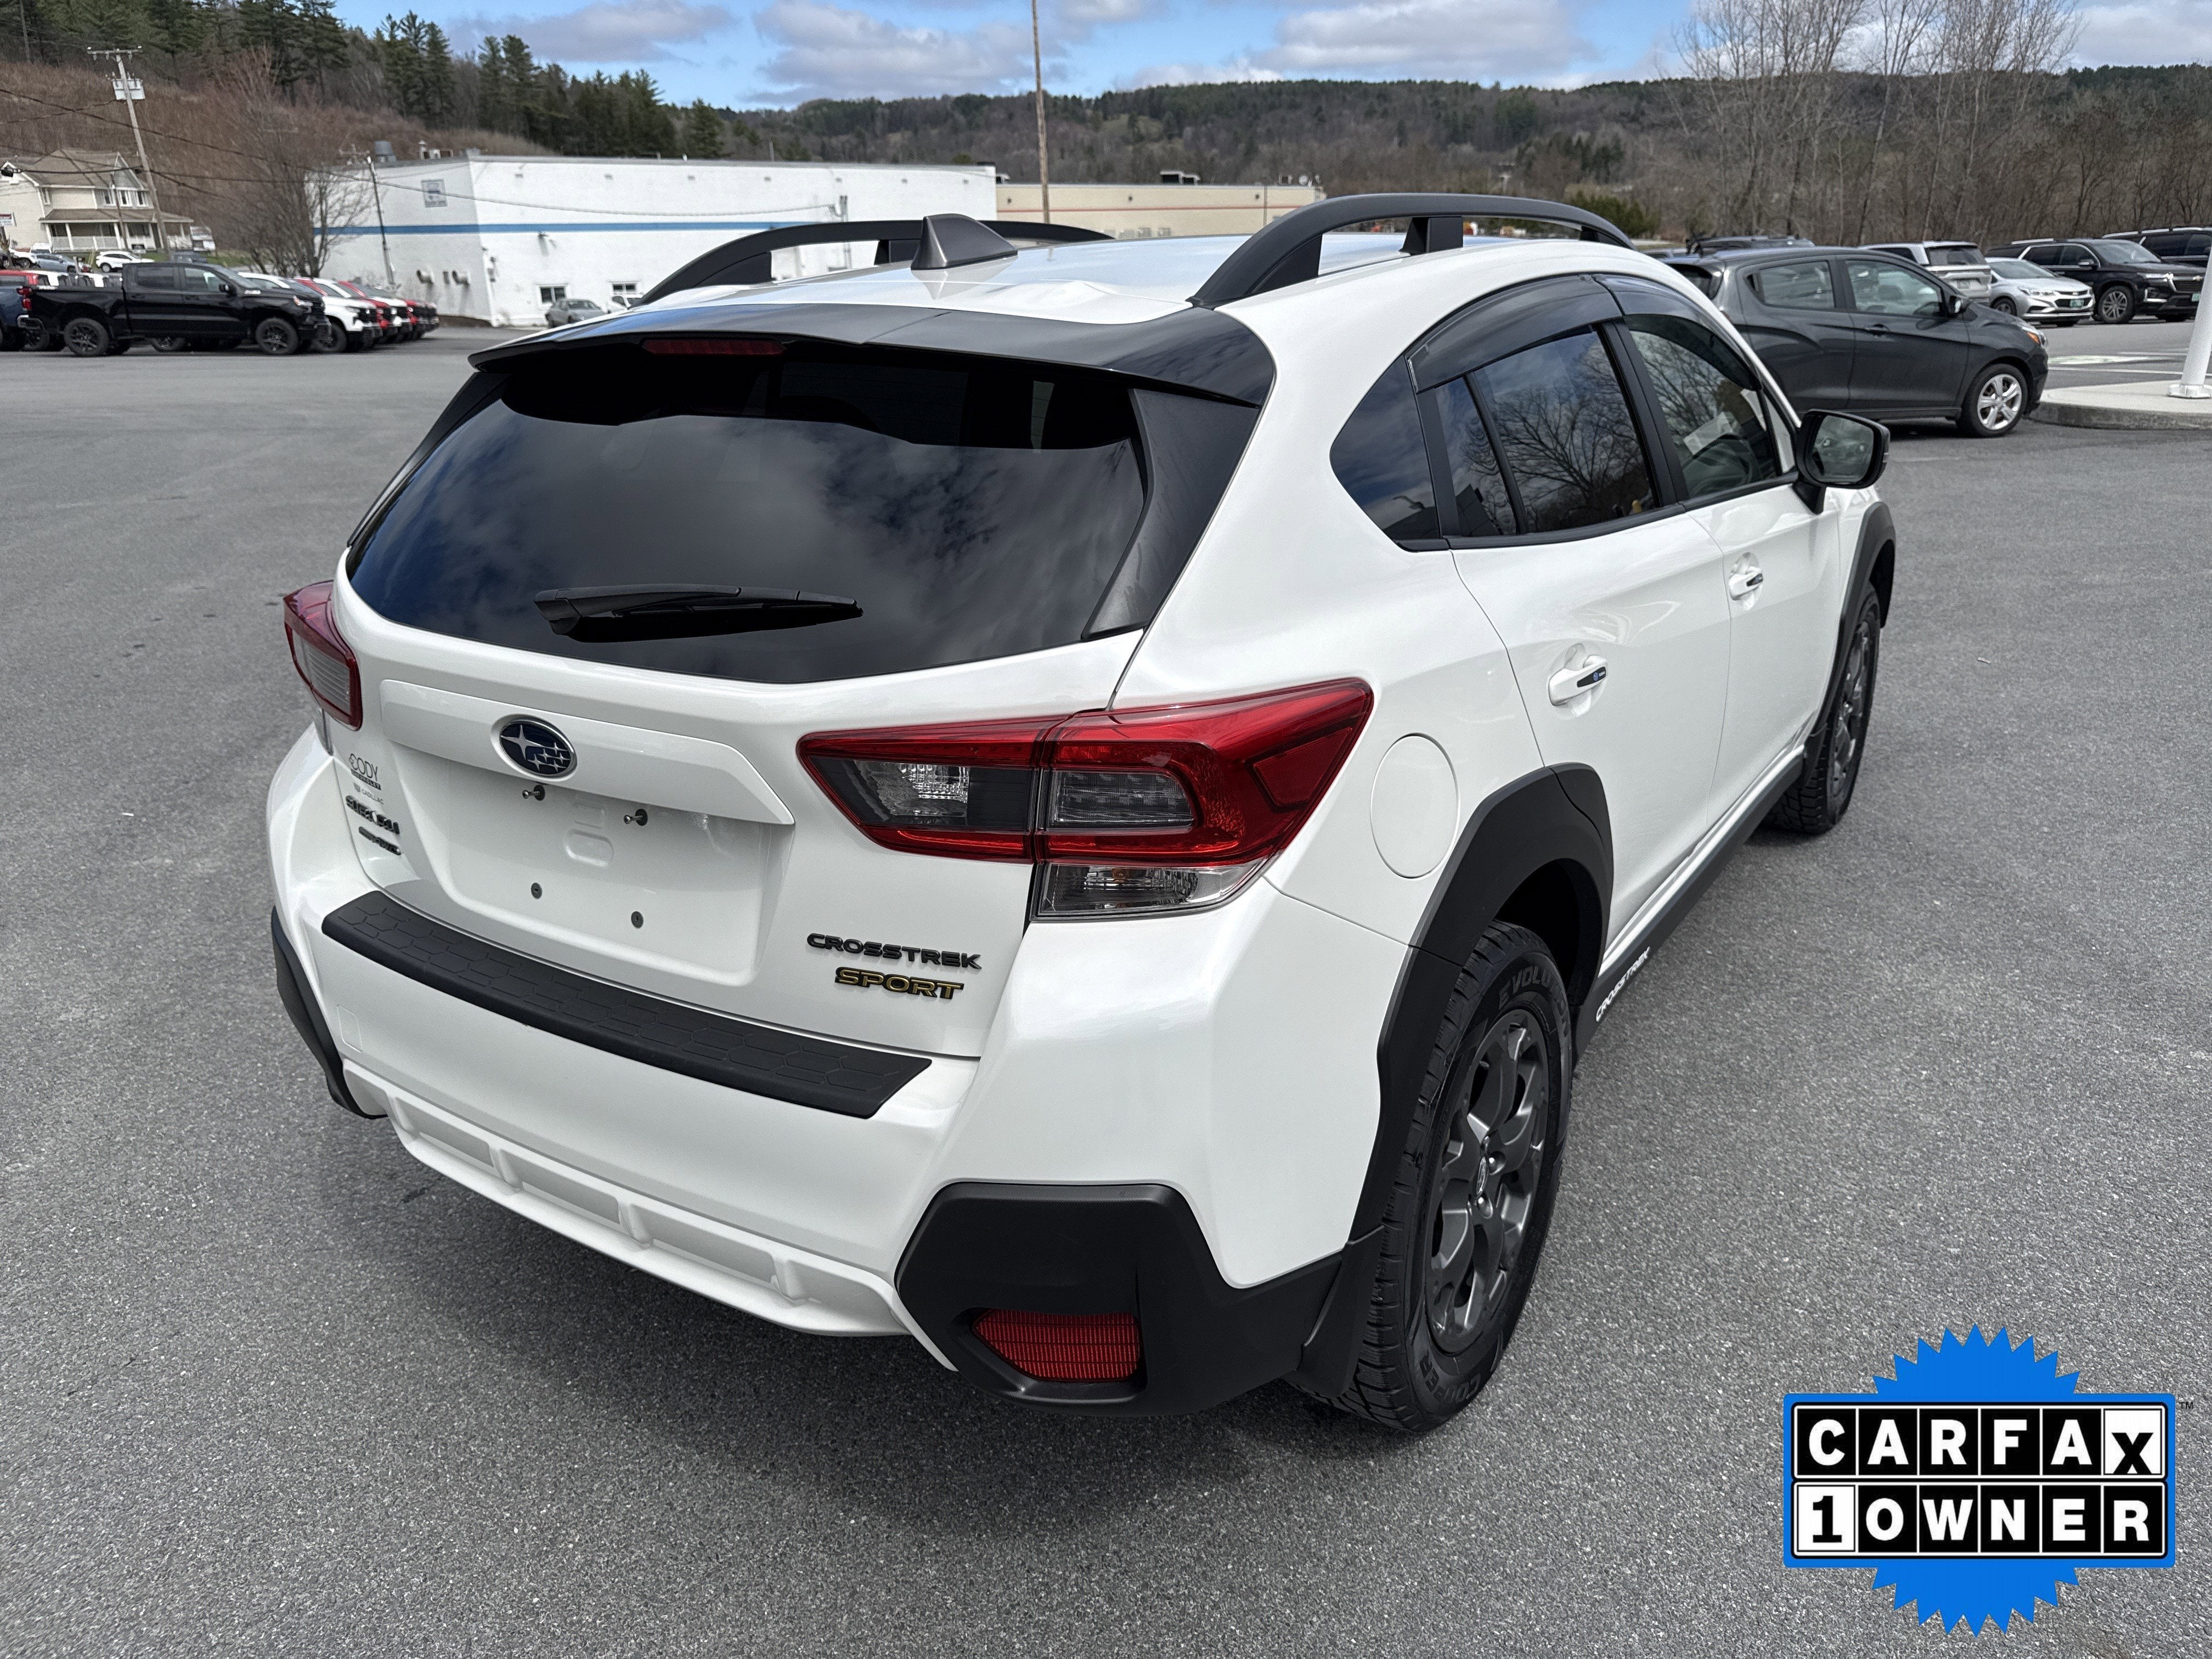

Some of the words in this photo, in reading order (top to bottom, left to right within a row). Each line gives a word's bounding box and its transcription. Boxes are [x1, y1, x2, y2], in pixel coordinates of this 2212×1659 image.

[349, 753, 378, 781] CODY
[806, 933, 982, 969] CROSSTREK
[834, 967, 964, 1000] SPORT
[1596, 946, 1650, 1022] CROSSTREK
